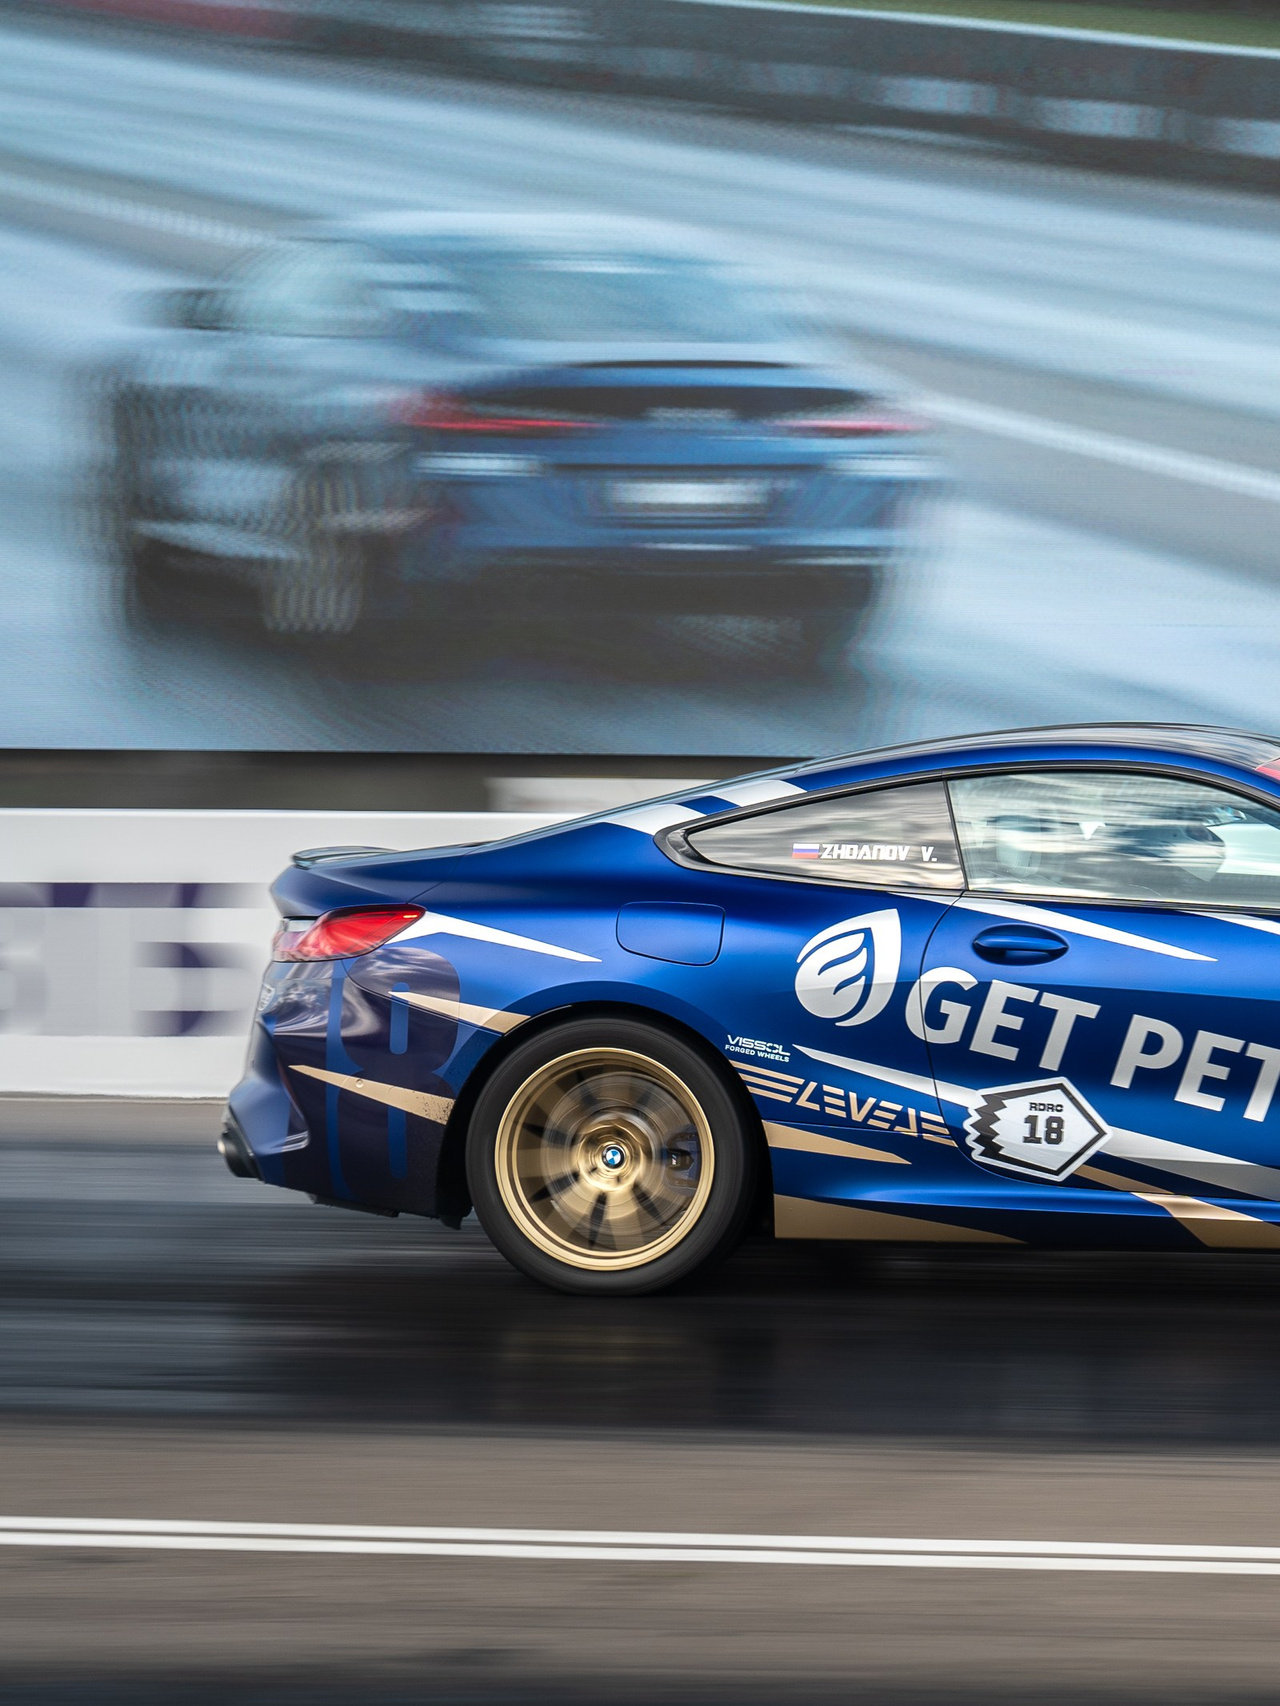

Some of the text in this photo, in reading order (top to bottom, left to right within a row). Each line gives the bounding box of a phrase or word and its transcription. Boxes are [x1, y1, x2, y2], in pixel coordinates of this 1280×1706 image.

[820, 843, 938, 862] ZHDANOV V.
[904, 966, 1101, 1072] GET
[724, 1044, 790, 1063] FORGED WHEELS
[727, 1034, 791, 1056] VISSOL
[1029, 1102, 1064, 1113] RDRC
[1022, 1115, 1065, 1145] 18
